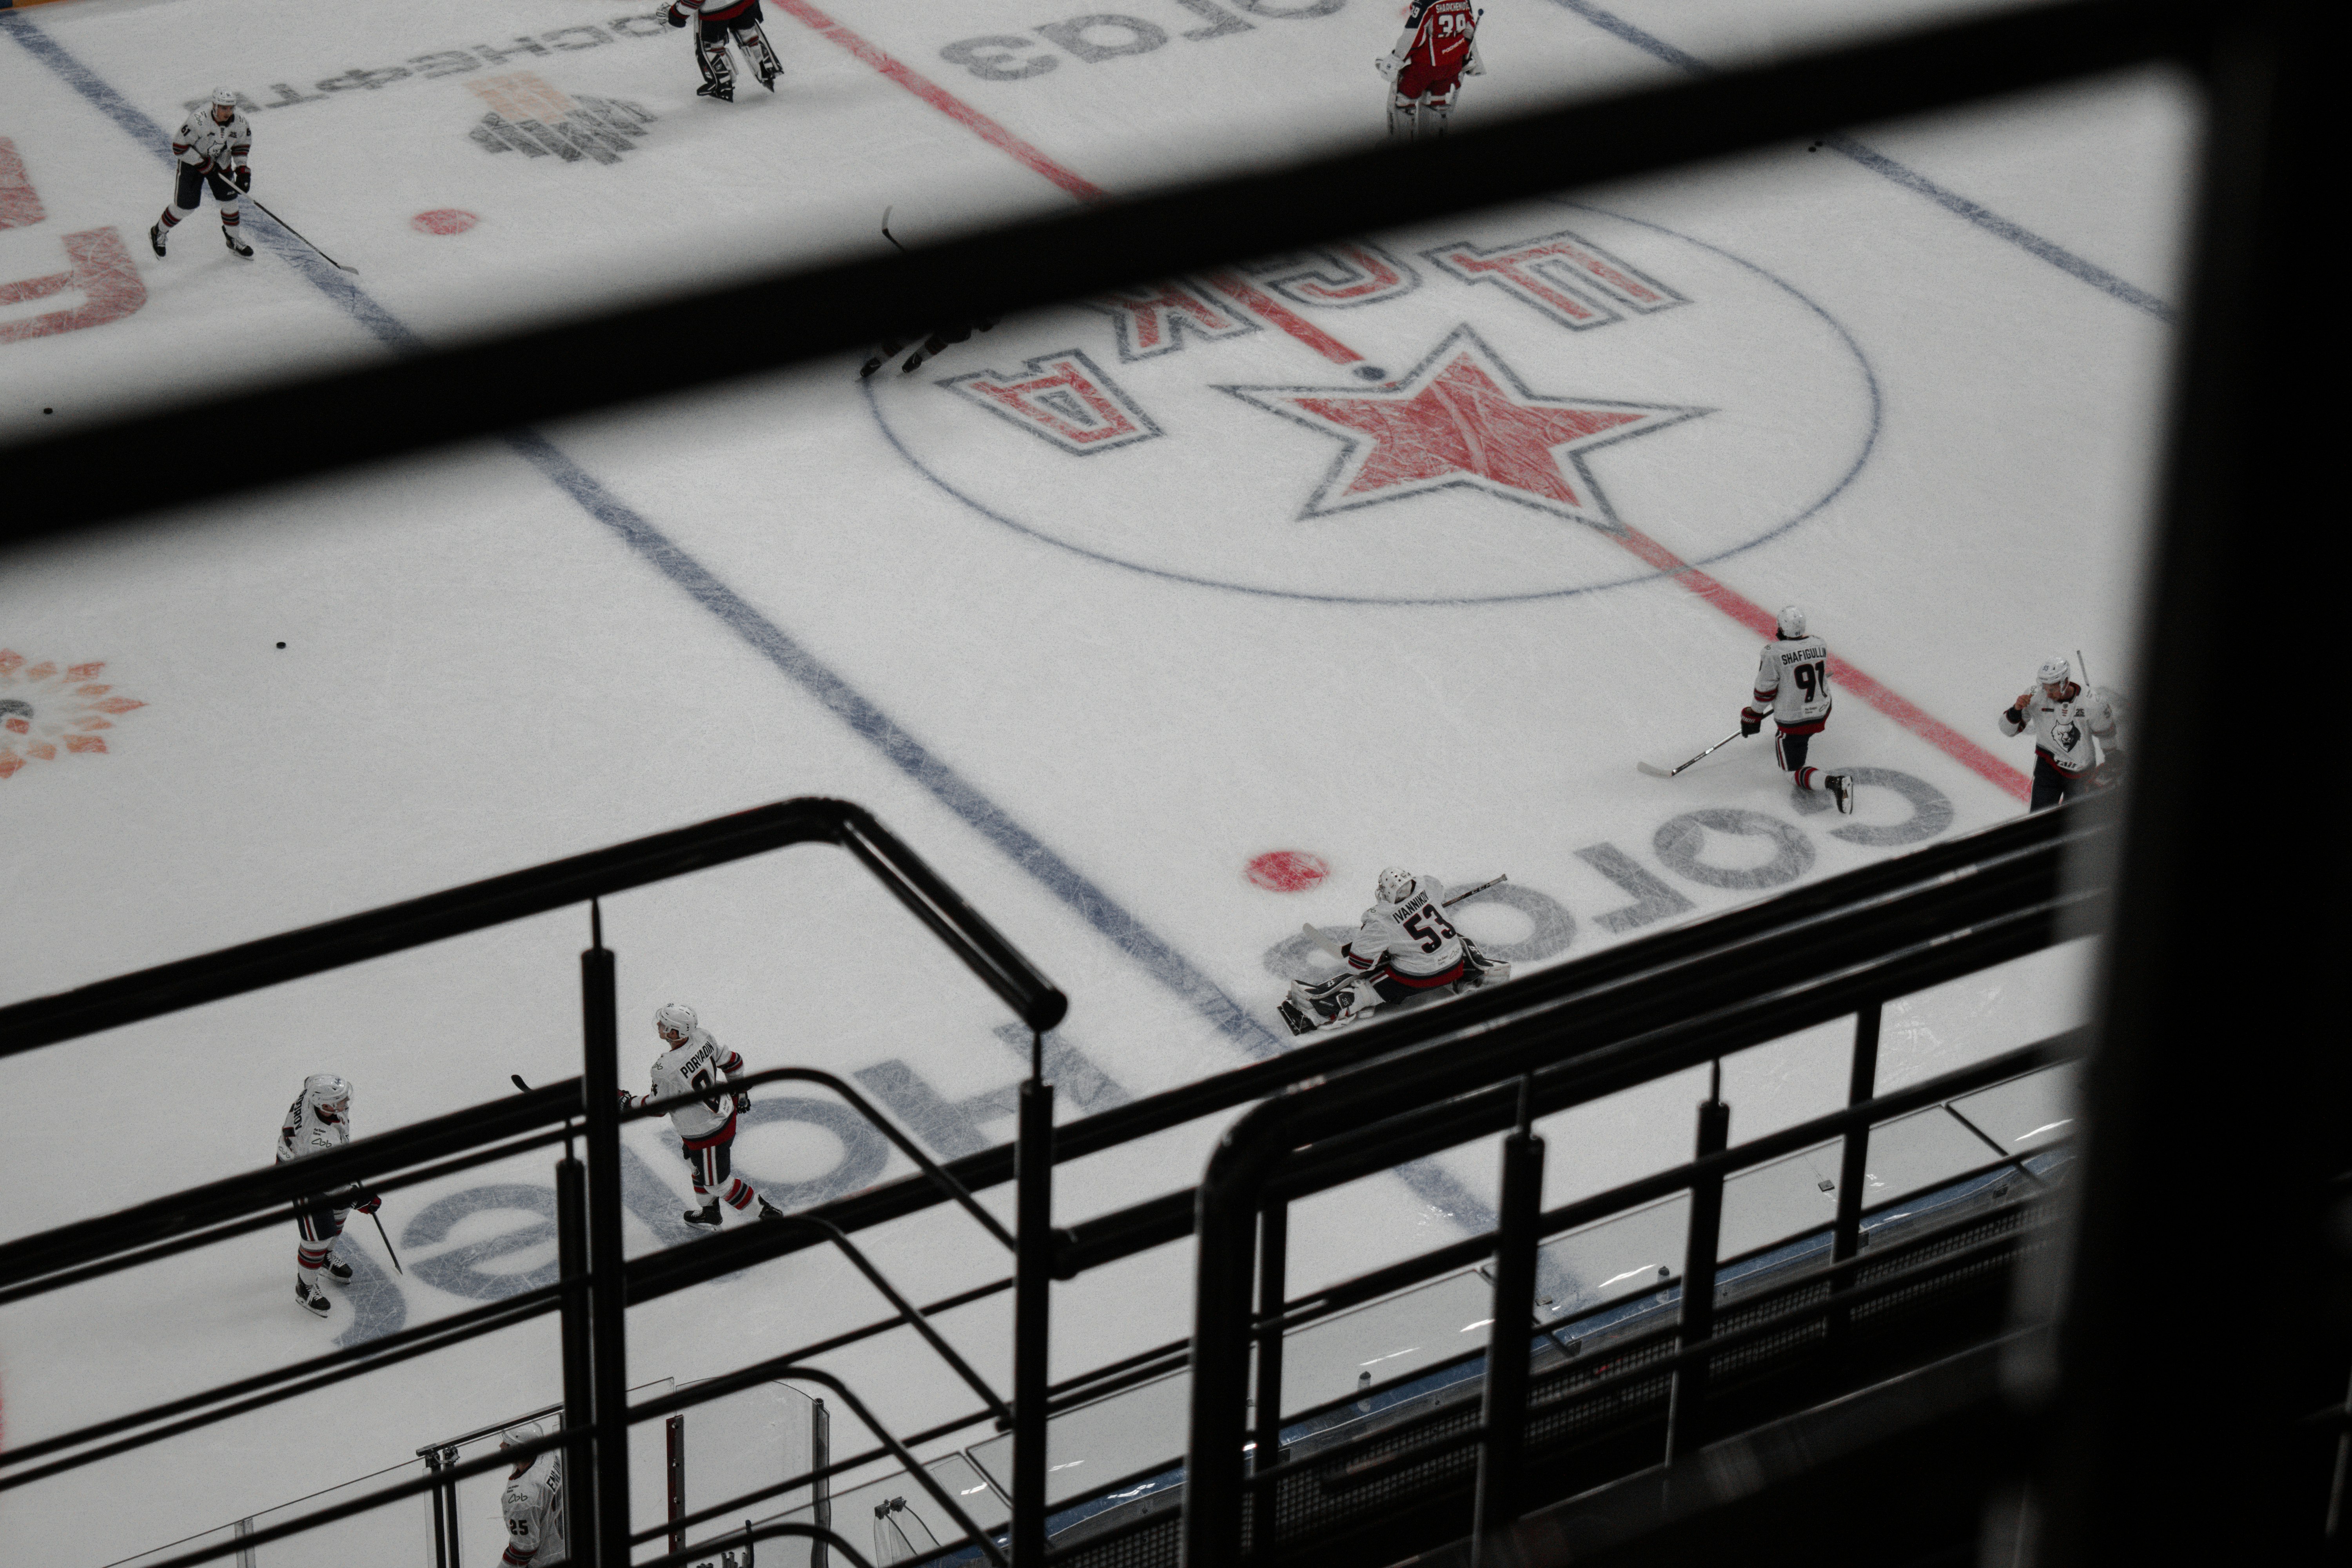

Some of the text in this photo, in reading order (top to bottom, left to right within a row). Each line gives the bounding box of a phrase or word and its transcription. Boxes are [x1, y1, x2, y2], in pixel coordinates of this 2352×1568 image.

[182, 11, 682, 114] ОСНЕФТЬ
[181, 125, 191, 136] 61
[1781, 647, 1826, 665] SHAFIGULLIN
[1794, 660, 1827, 703] 91
[1392, 890, 1429, 924] IVANNIKOV
[1403, 903, 1456, 953] 53
[680, 1041, 715, 1079] PORYADIN
[510, 1519, 528, 1535] 25
